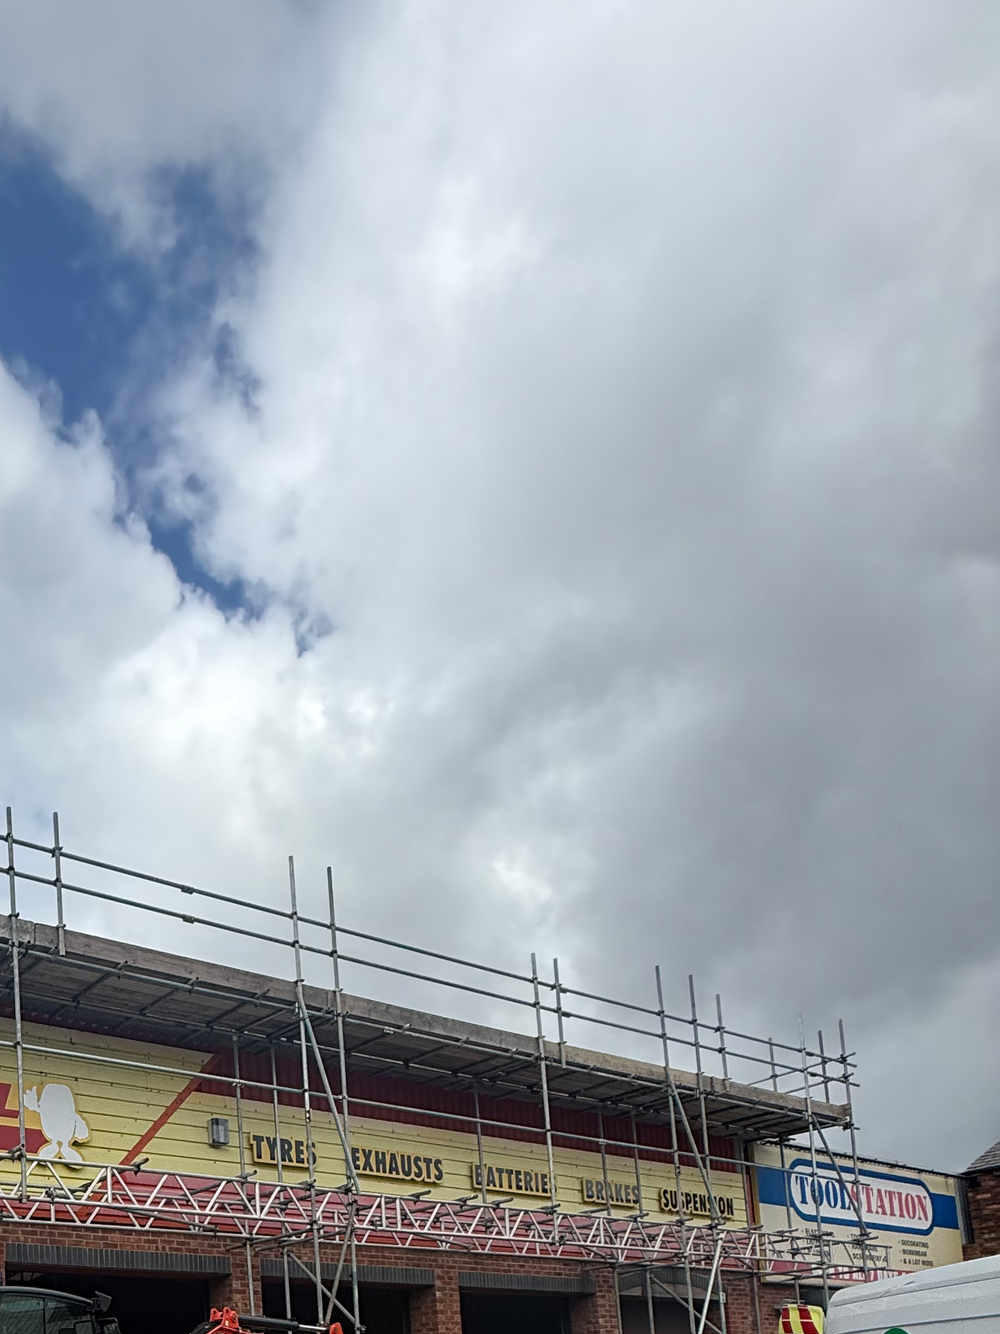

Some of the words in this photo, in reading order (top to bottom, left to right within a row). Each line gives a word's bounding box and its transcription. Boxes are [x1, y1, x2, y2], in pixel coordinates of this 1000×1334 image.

[252, 1134, 317, 1165] TYRES
[352, 1146, 444, 1181] EXHAUSTS
[585, 1179, 640, 1205] BRAKES
[795, 1175, 929, 1222] TOOLSTATION
